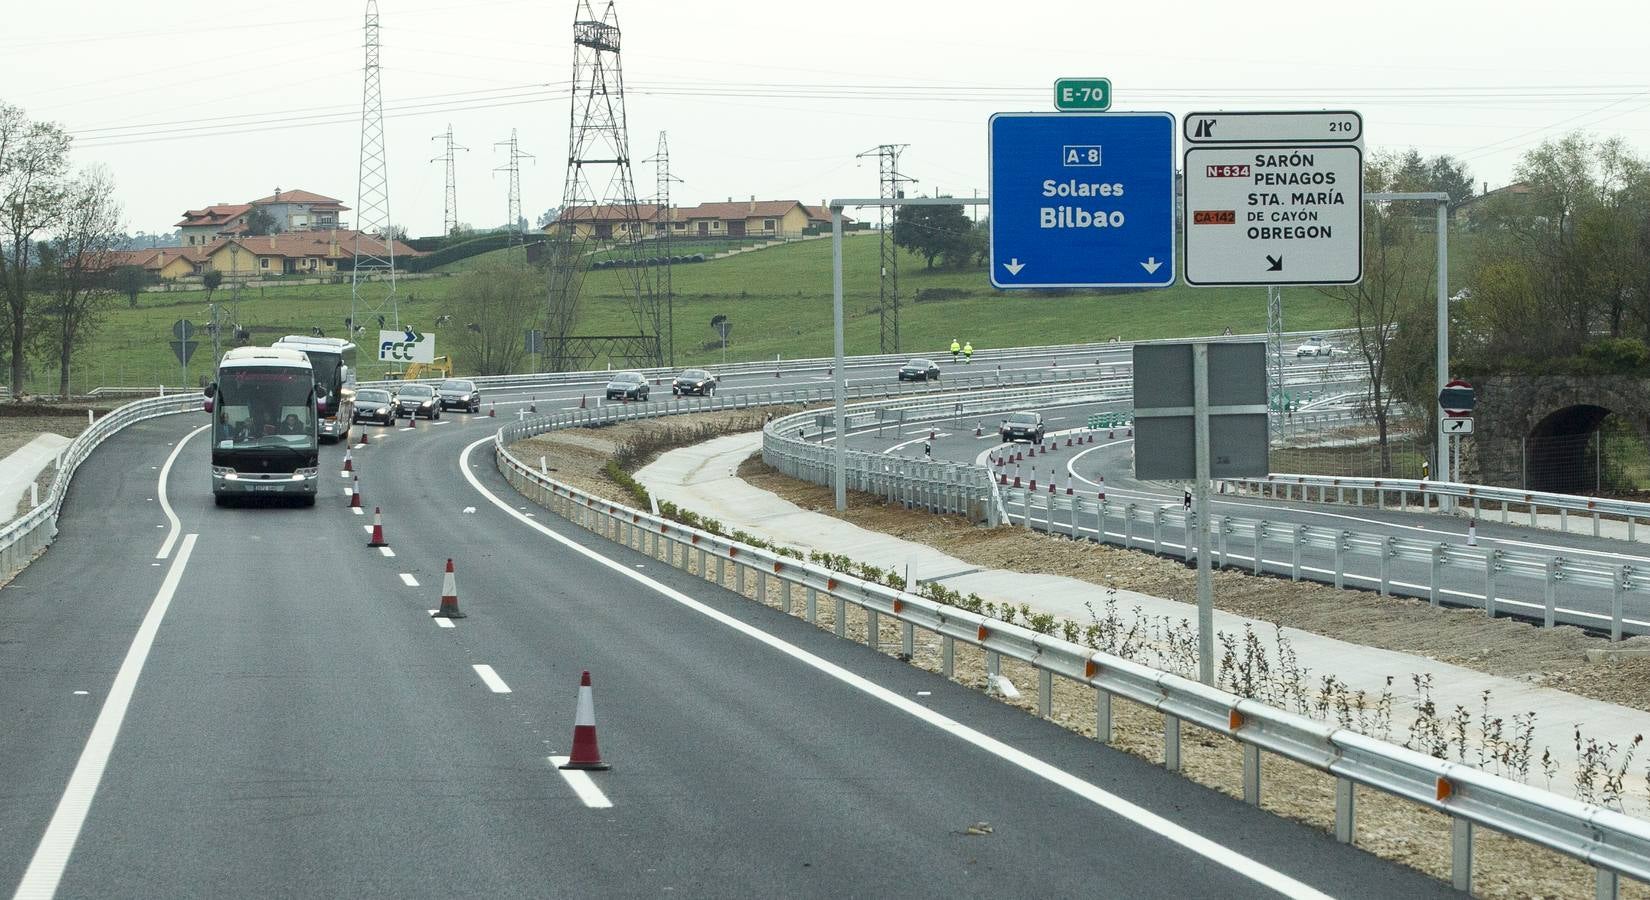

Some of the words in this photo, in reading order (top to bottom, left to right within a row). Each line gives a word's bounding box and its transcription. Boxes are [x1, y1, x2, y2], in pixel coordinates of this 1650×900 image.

[1063, 87, 1103, 102] E-70
[1329, 121, 1352, 132] 210
[1066, 149, 1099, 163] A-8
[1255, 151, 1314, 167] SARÓN
[1207, 166, 1250, 177] N-634
[1254, 172, 1336, 186] PENAGOS
[1042, 179, 1124, 197] Solares
[1247, 193, 1285, 206] STA.
[1291, 188, 1345, 205] MARÍA
[1040, 205, 1125, 229] Bilbao
[1194, 211, 1235, 223] CA-142
[1247, 211, 1265, 222] DE
[1271, 208, 1318, 222] CAYÓN
[1247, 225, 1332, 240] OBREGON
[381, 341, 415, 360] FCC
